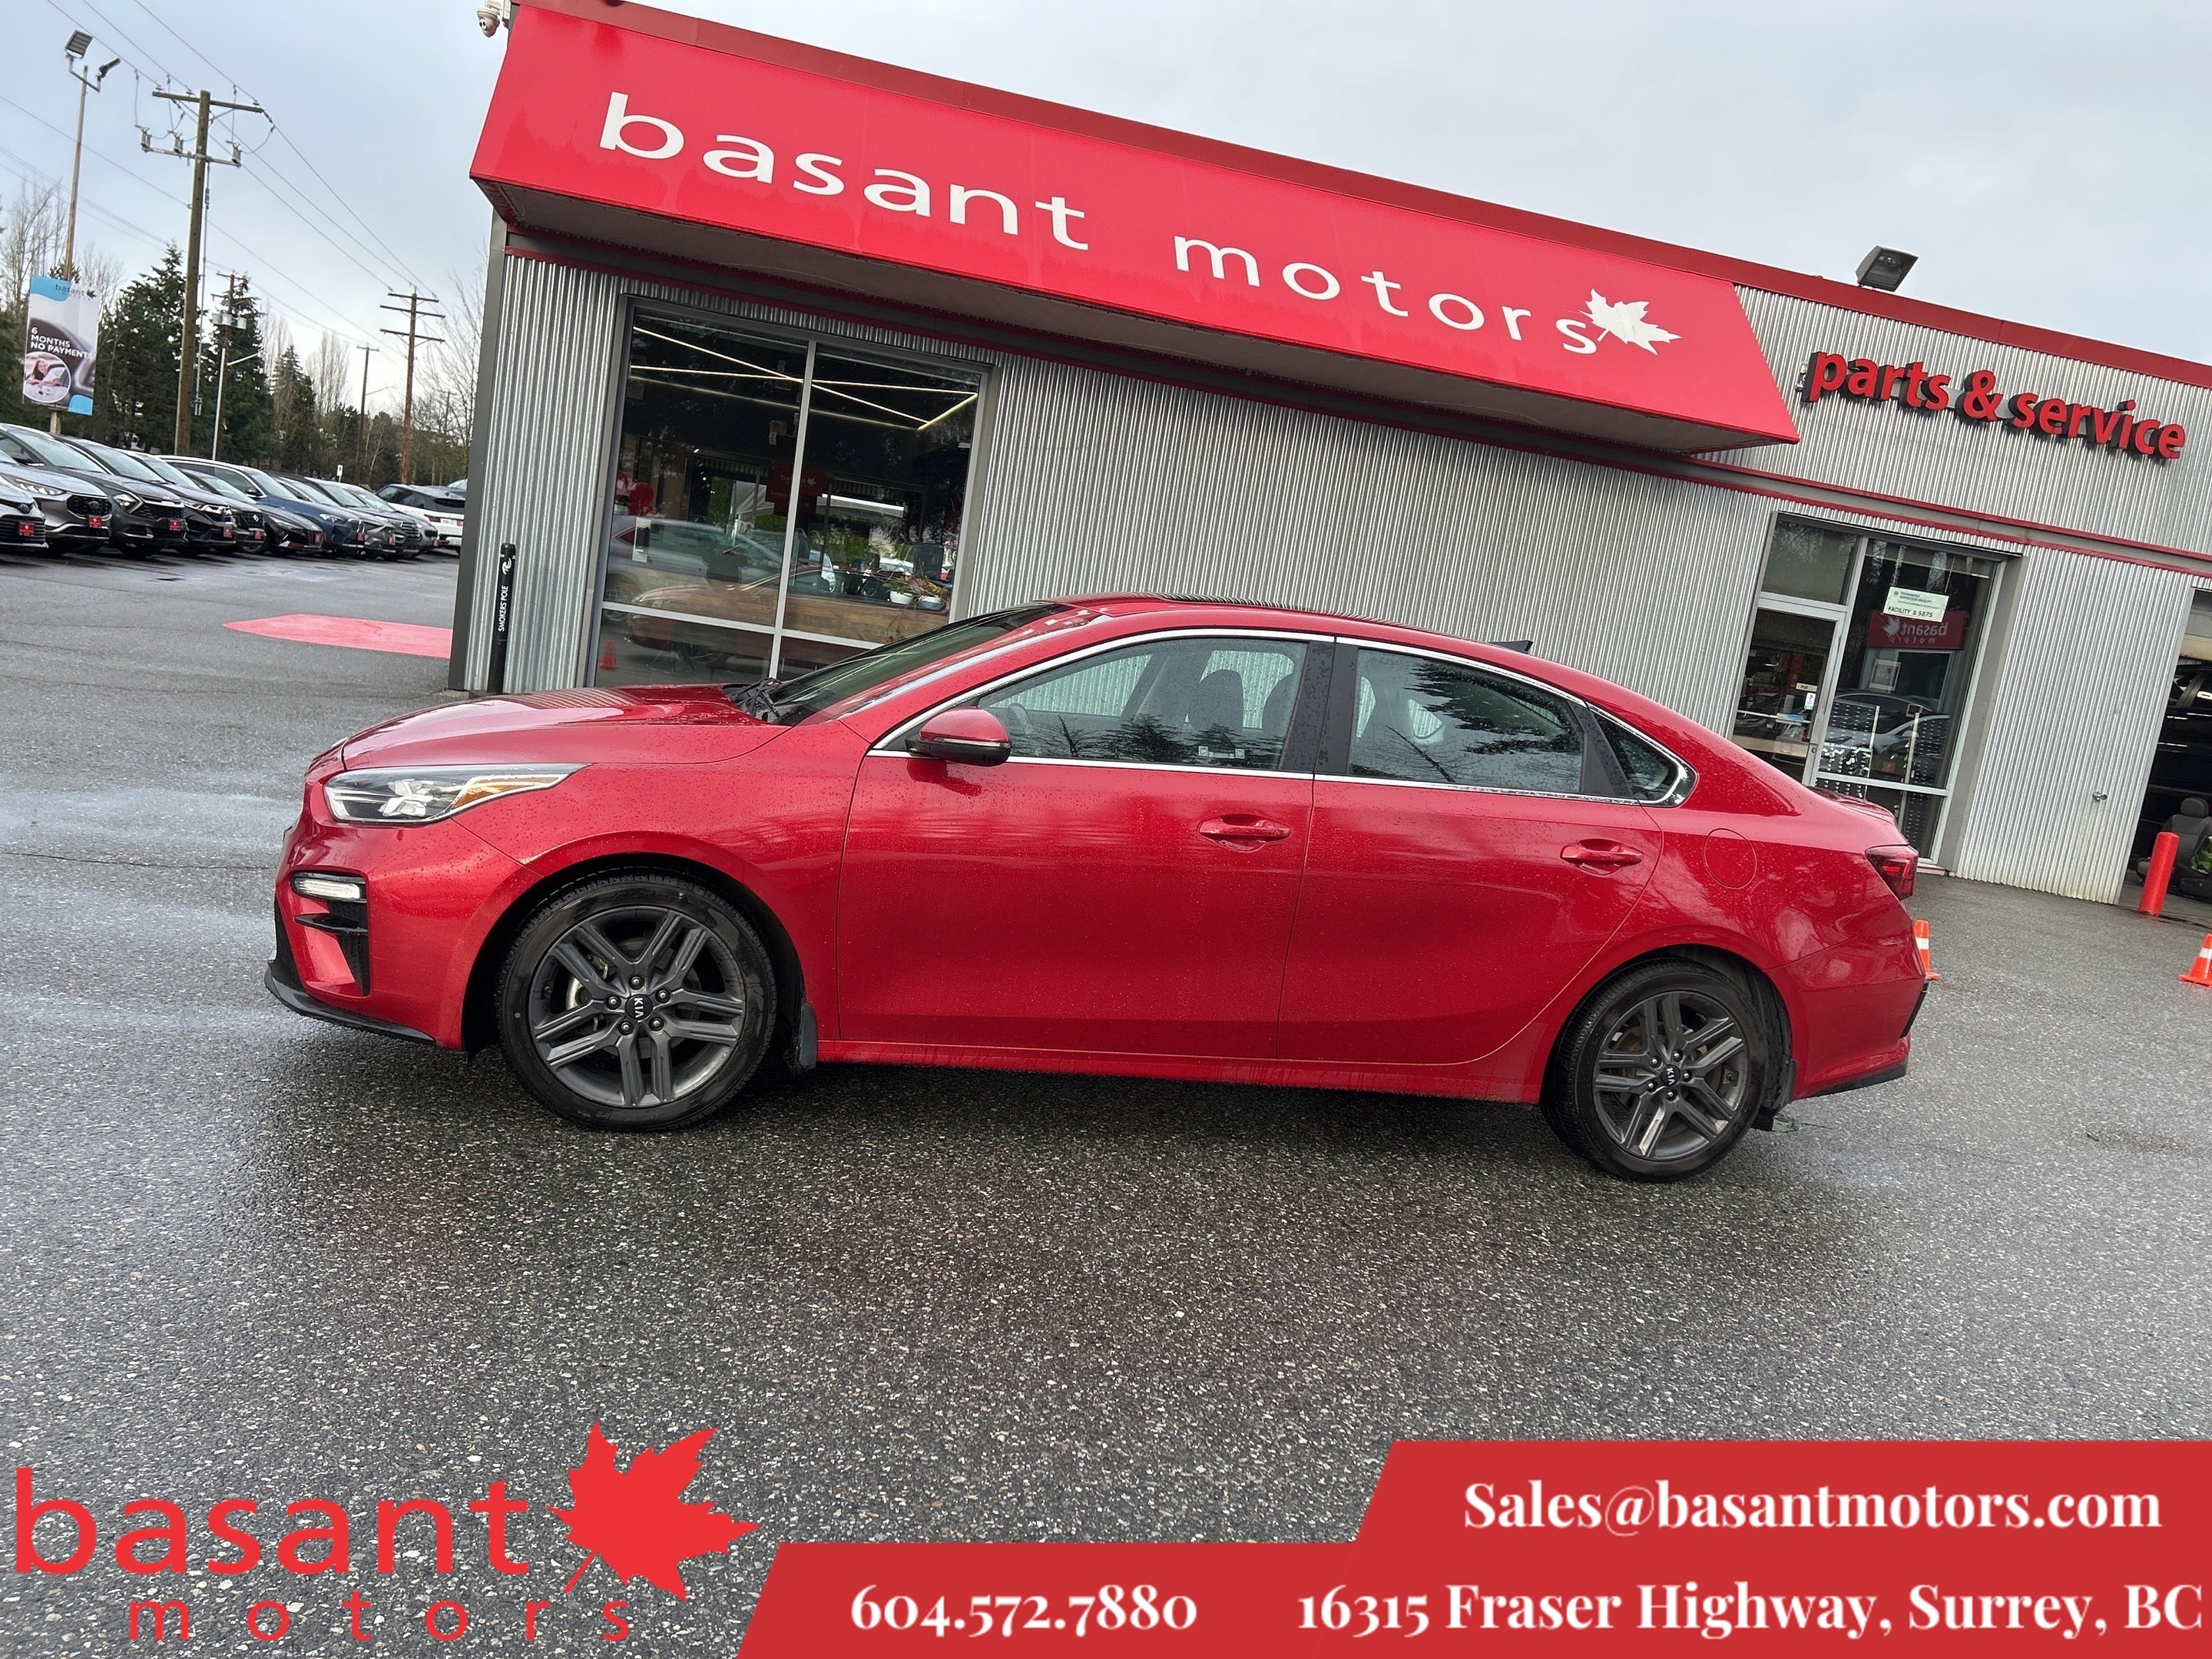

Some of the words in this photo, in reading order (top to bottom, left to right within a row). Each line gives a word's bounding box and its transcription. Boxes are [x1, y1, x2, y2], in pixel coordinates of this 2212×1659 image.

[599, 91, 1088, 250] basant
[1174, 236, 1597, 356] motors
[55, 283, 84, 296] basant
[31, 334, 71, 348] MONTHS
[31, 342, 46, 350] NO
[1803, 350, 1951, 412] parts
[1959, 369, 2002, 422] &
[2010, 392, 2186, 460] service
[500, 584, 508, 601] POLE
[498, 601, 507, 632] SMOKERS
[1888, 606, 1911, 614] FACILITY
[634, 997, 644, 1018] KIA
[1666, 1068, 1675, 1085] KIA
